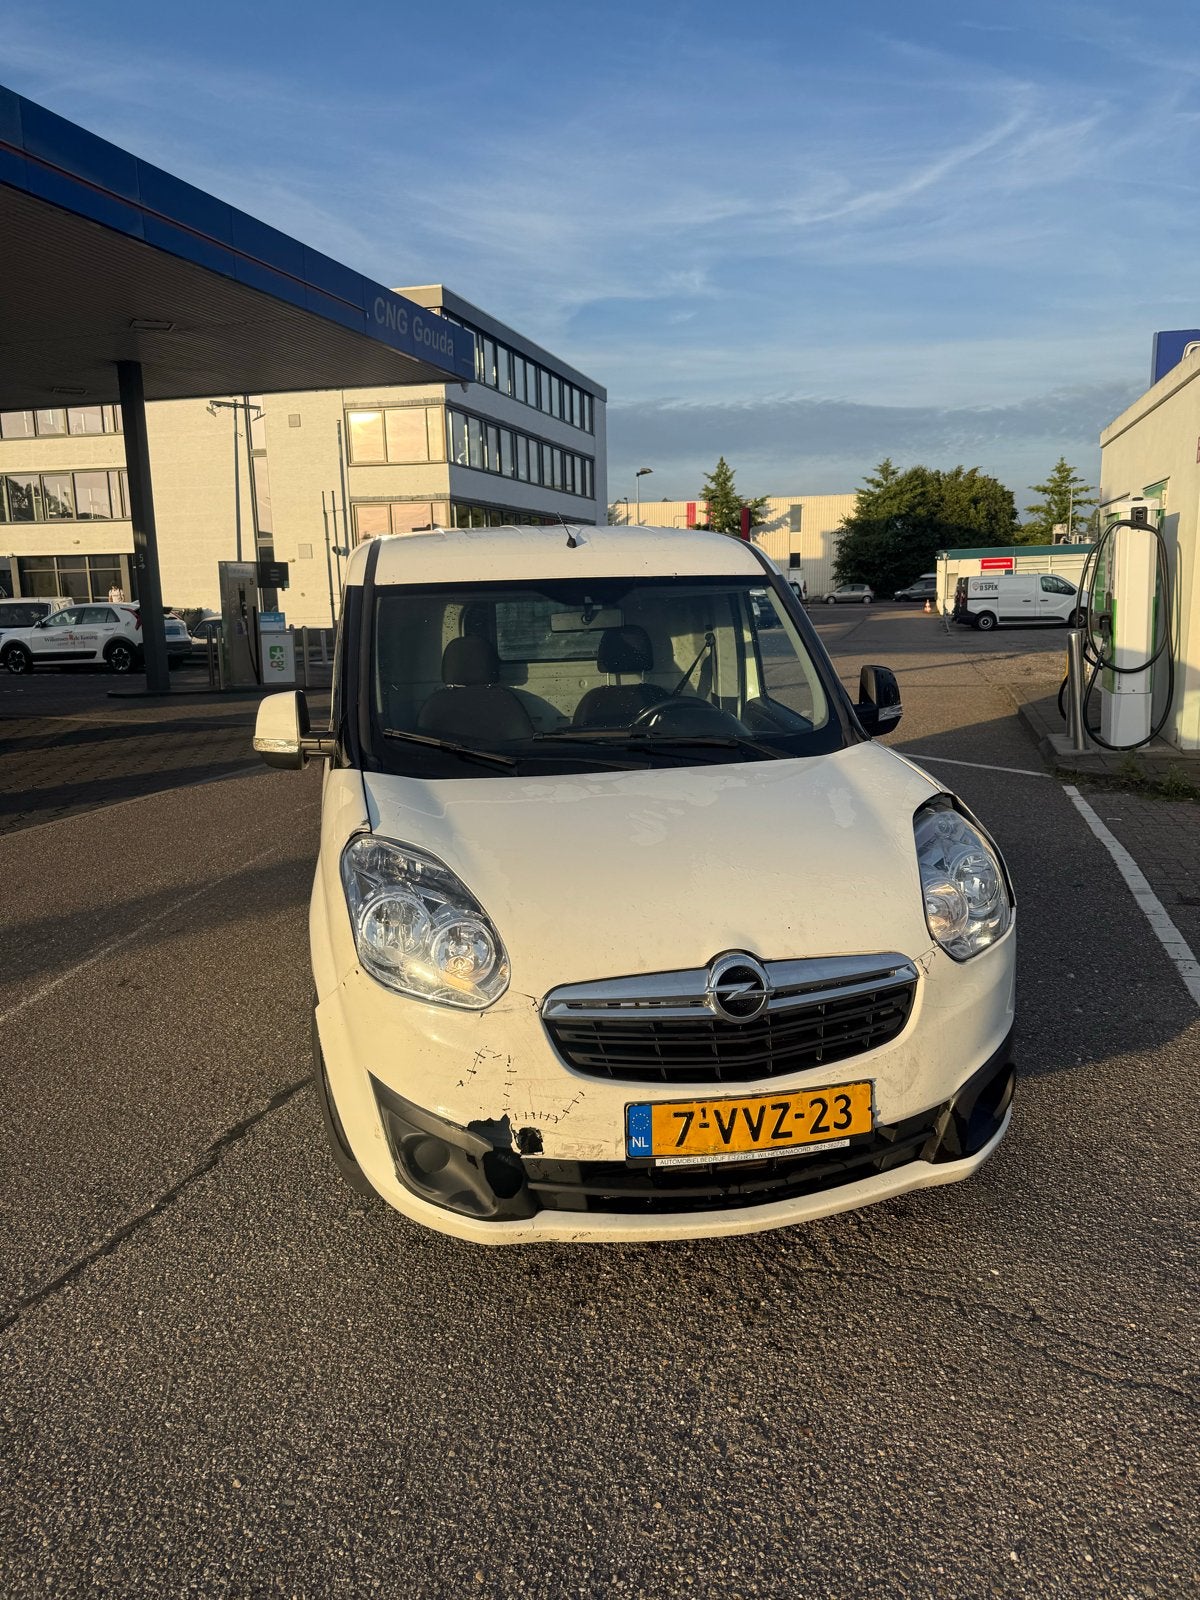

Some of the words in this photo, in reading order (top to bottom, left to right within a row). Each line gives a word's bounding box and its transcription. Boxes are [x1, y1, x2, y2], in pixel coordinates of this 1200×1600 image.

[374, 296, 408, 335] CNG
[412, 315, 454, 357] Gouda
[631, 1135, 650, 1149] NL
